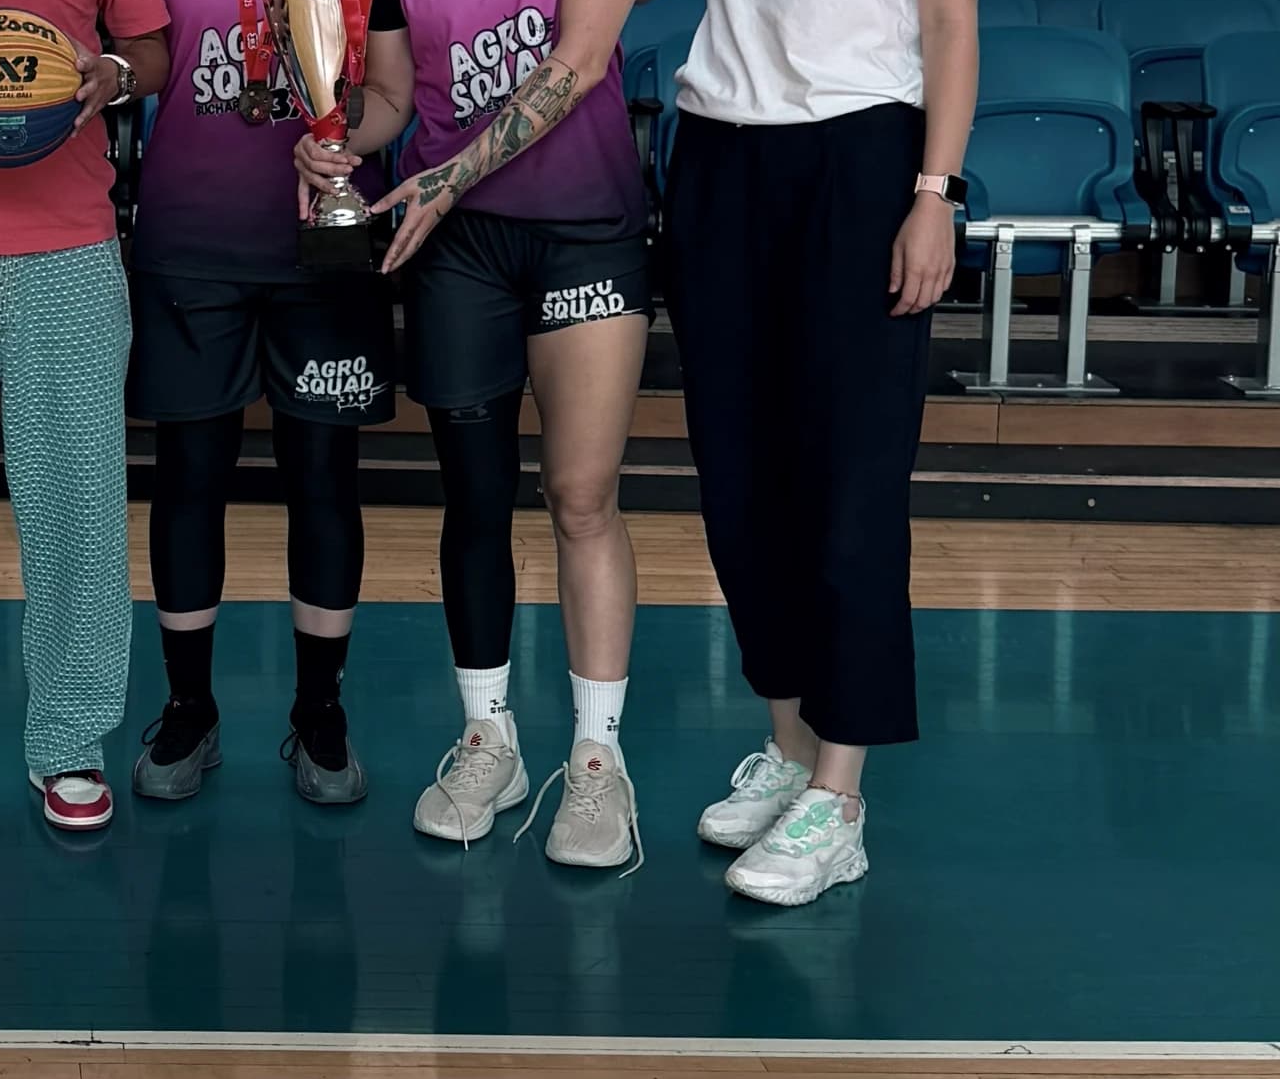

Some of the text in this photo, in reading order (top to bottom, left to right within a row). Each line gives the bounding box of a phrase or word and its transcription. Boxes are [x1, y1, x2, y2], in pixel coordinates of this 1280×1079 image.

[449, 6, 546, 83] AGRO
[541, 293, 625, 320] SQUAD
[303, 355, 367, 378] AGRO
[295, 371, 374, 396] SQUAD
